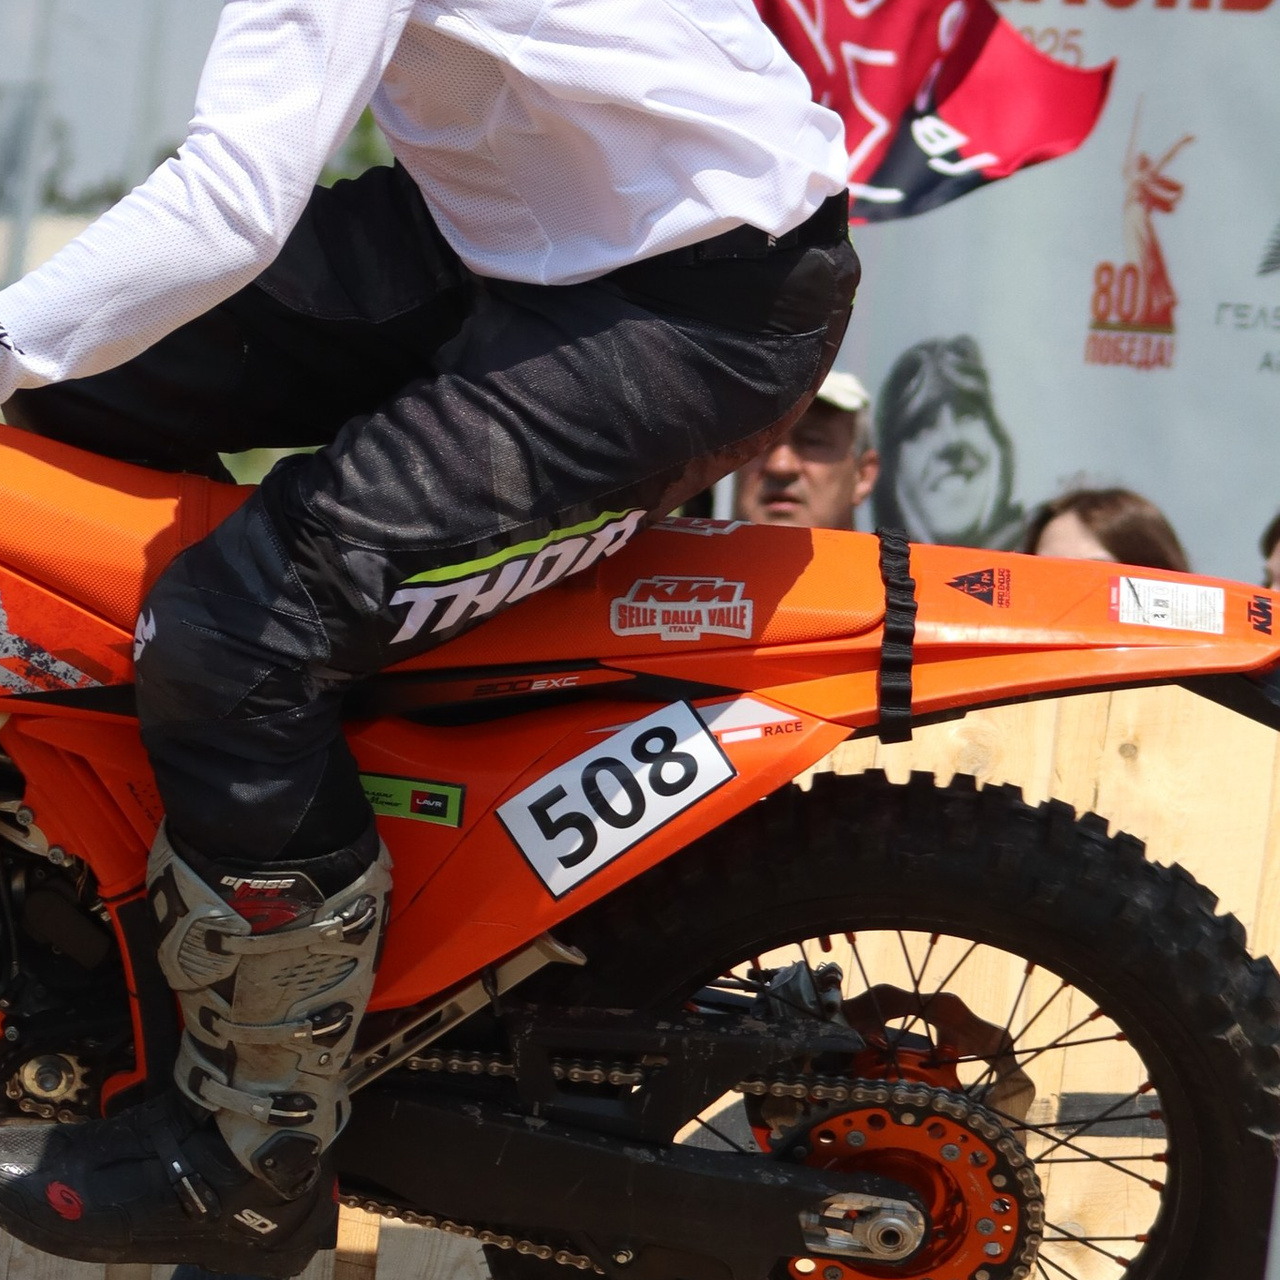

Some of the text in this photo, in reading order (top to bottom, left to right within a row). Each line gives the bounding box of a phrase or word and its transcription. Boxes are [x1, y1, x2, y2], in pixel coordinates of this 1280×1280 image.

[389, 510, 647, 645] THOR
[631, 578, 737, 603] KTM
[618, 604, 747, 630] SELLE DALLA VALLE
[1247, 595, 1272, 635] KTM
[763, 721, 804, 737] RACE
[416, 798, 442, 808] LAVR
[528, 726, 699, 869] 508
